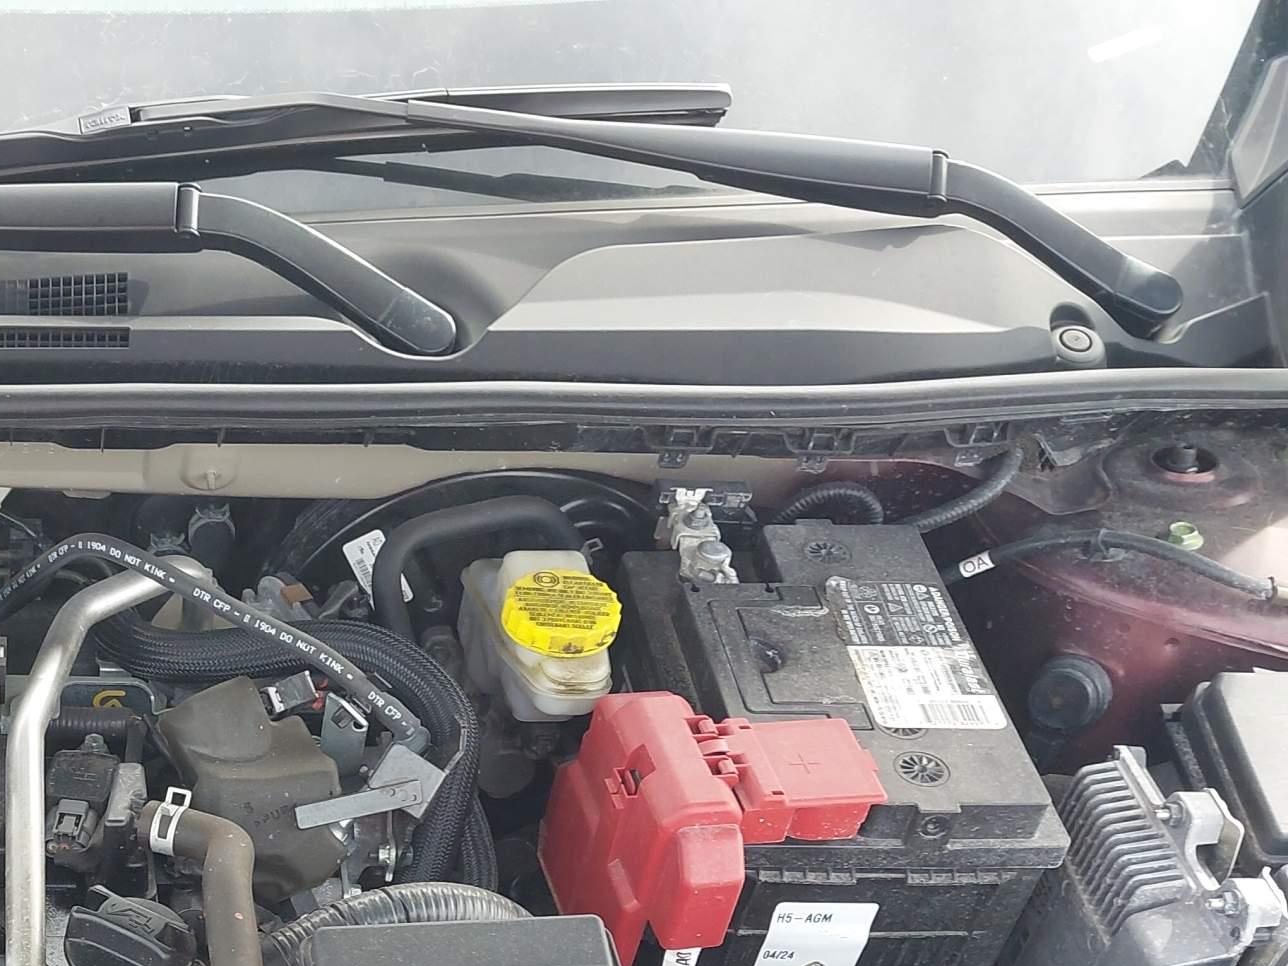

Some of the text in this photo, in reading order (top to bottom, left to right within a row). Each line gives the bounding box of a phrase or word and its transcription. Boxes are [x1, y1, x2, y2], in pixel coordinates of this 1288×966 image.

[109, 547, 122, 558] DO
[124, 553, 142, 567] NOT
[144, 562, 167, 579] KINK
[192, 587, 212, 602] DTR
[213, 598, 232, 612] CFP
[254, 619, 276, 635] 1904
[279, 631, 294, 644] DO
[295, 640, 317, 654] NOT
[319, 652, 345, 674] KINK
[367, 691, 386, 708] DTR
[384, 706, 402, 720] CFP
[762, 950, 794, 960] 04/24
